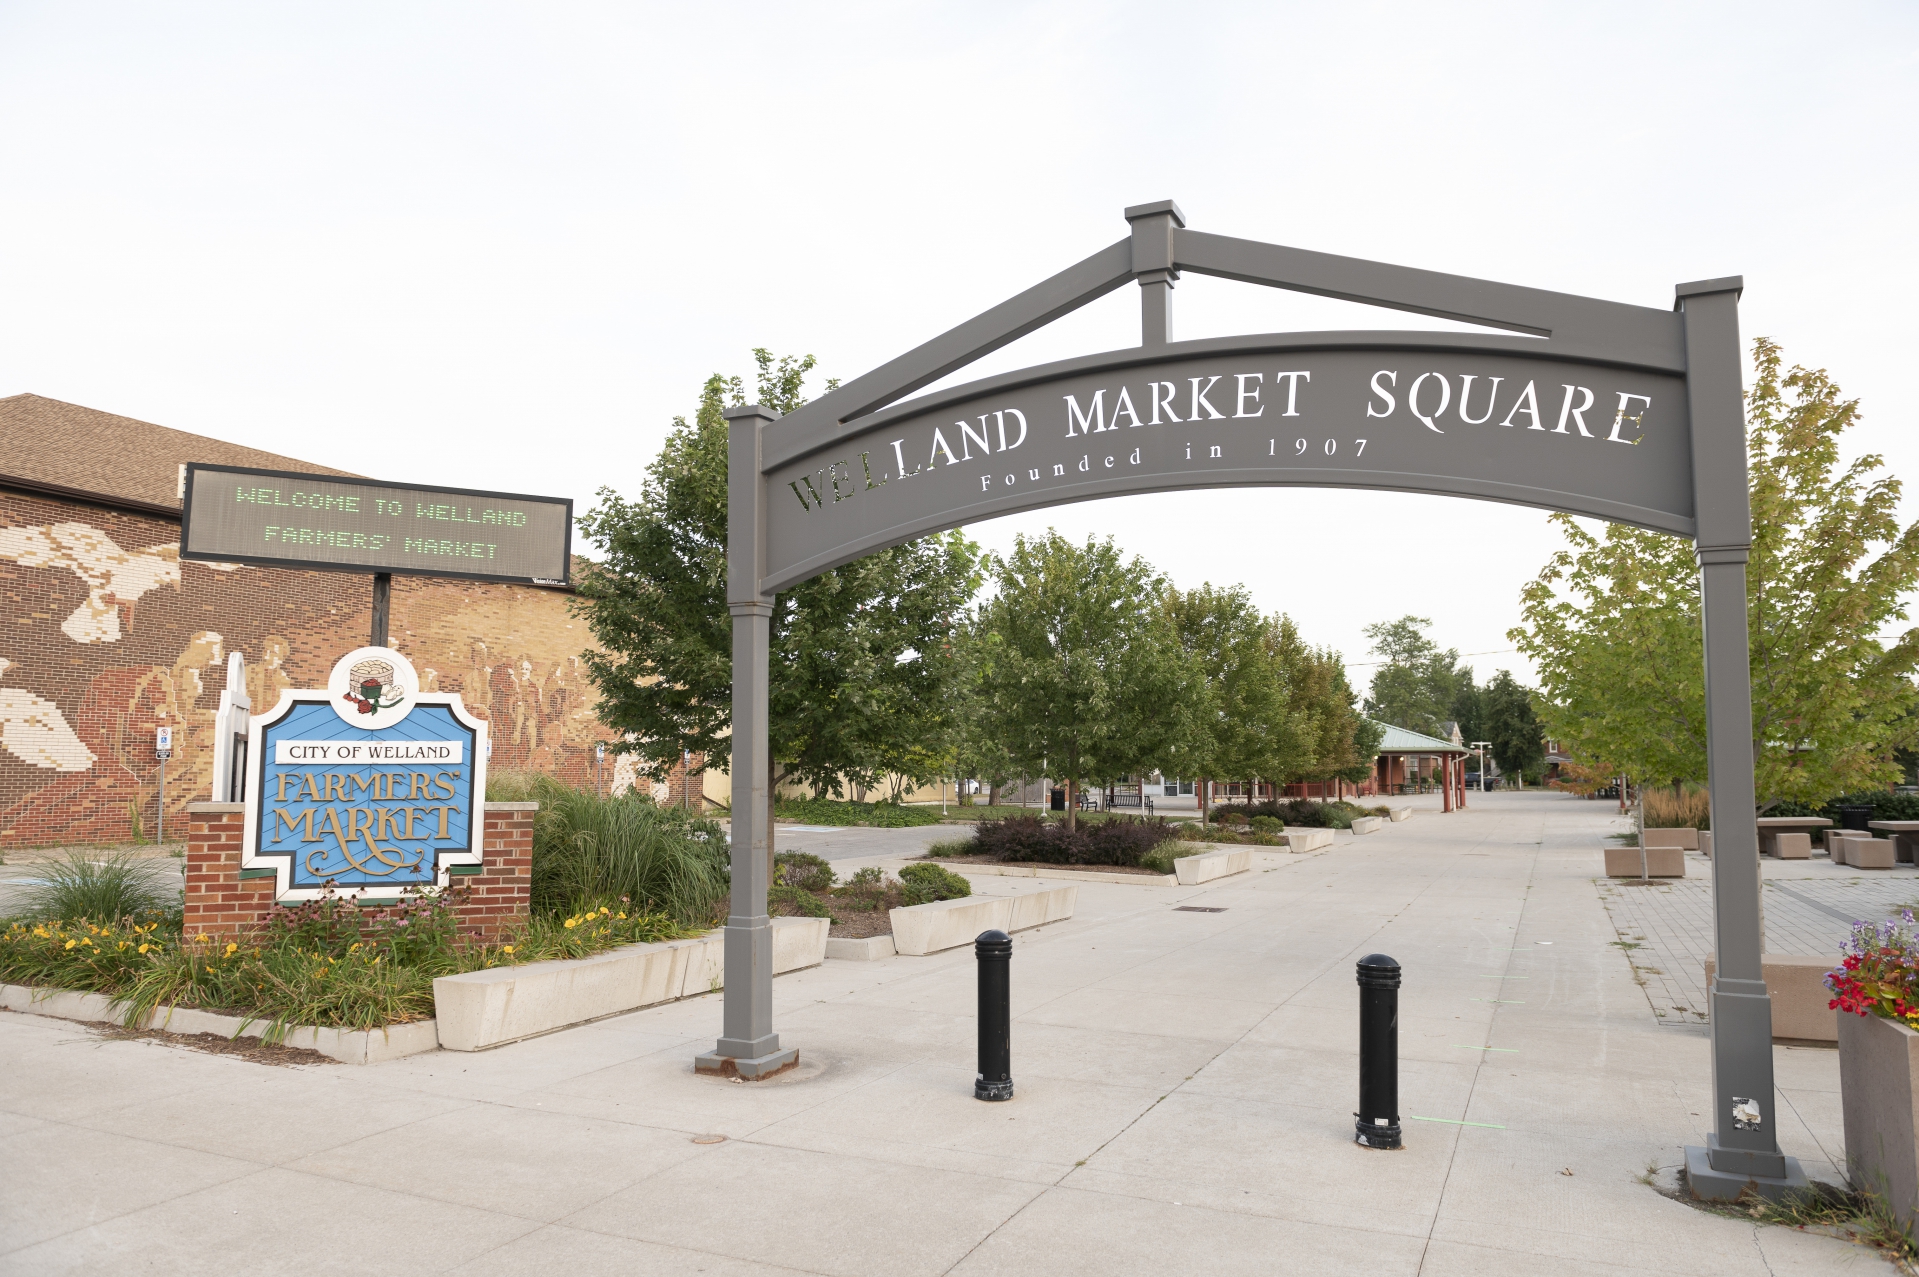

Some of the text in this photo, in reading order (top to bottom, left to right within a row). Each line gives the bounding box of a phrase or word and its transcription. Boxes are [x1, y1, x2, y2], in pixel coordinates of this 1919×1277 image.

[788, 370, 1651, 515] WELLAND MARKET SQUARE
[980, 438, 1367, 492] Founded in 1907
[236, 487, 527, 527] WELCOME TO WELLAND
[264, 526, 498, 559] FARMERS' MARKET
[289, 745, 451, 759] CITY OF WELLAND
[271, 806, 461, 876] MARKET
